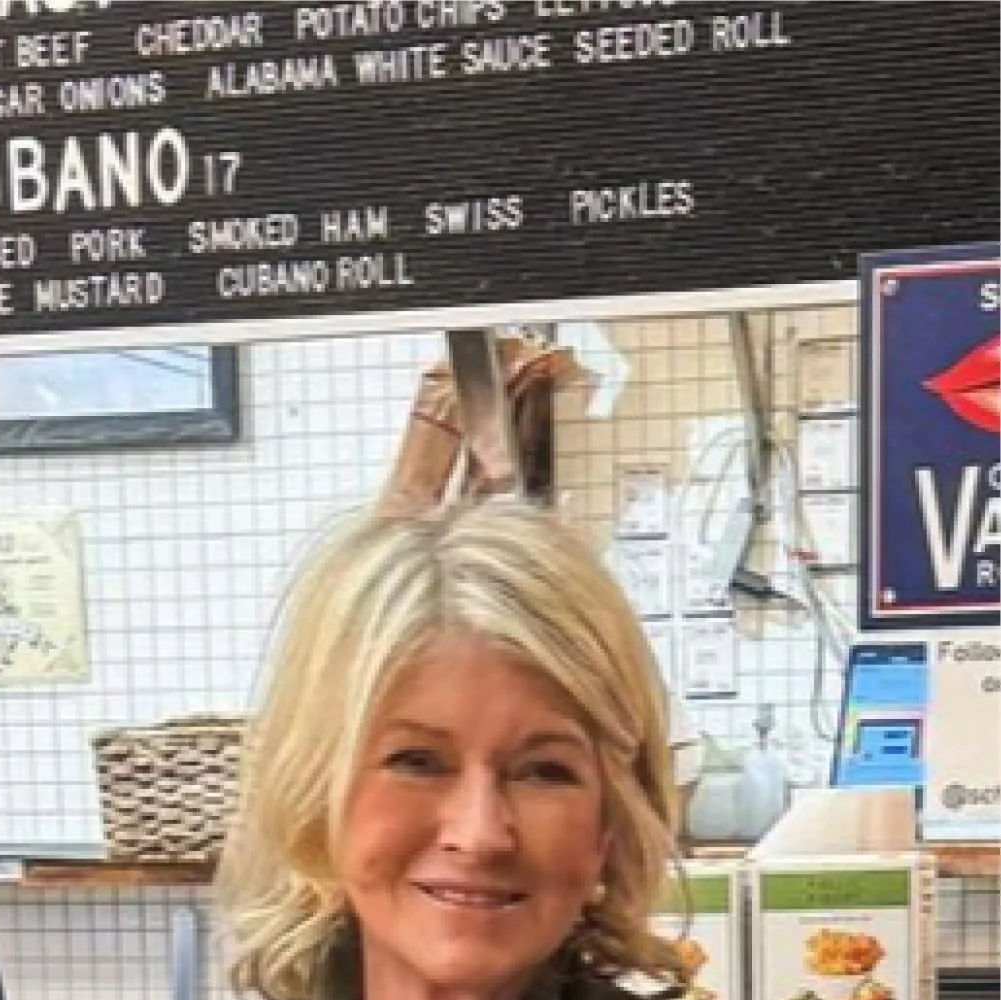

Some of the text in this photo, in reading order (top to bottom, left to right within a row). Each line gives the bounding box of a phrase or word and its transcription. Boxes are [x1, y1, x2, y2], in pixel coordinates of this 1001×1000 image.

[14, 31, 92, 68] BEEF
[136, 12, 264, 56] CHEDDAR
[296, 0, 403, 40] POTATO
[417, 0, 505, 28] CHIPS
[60, 69, 166, 113] ONIONS
[205, 54, 338, 99] ALABAMA
[353, 42, 451, 83] WHITE
[460, 32, 550, 75] SAUCE
[573, 19, 694, 63] SEEDED
[711, 11, 792, 51] ROLL
[202, 151, 241, 195] 17
[69, 228, 148, 264] PORK
[187, 213, 299, 253] SMOKED
[320, 206, 389, 243] HAM
[425, 195, 524, 235] SWISS
[568, 179, 695, 226] PICKLES
[33, 271, 166, 312] MUSTARD
[216, 259, 330, 298] CUBANO
[334, 253, 415, 290] ROLL
